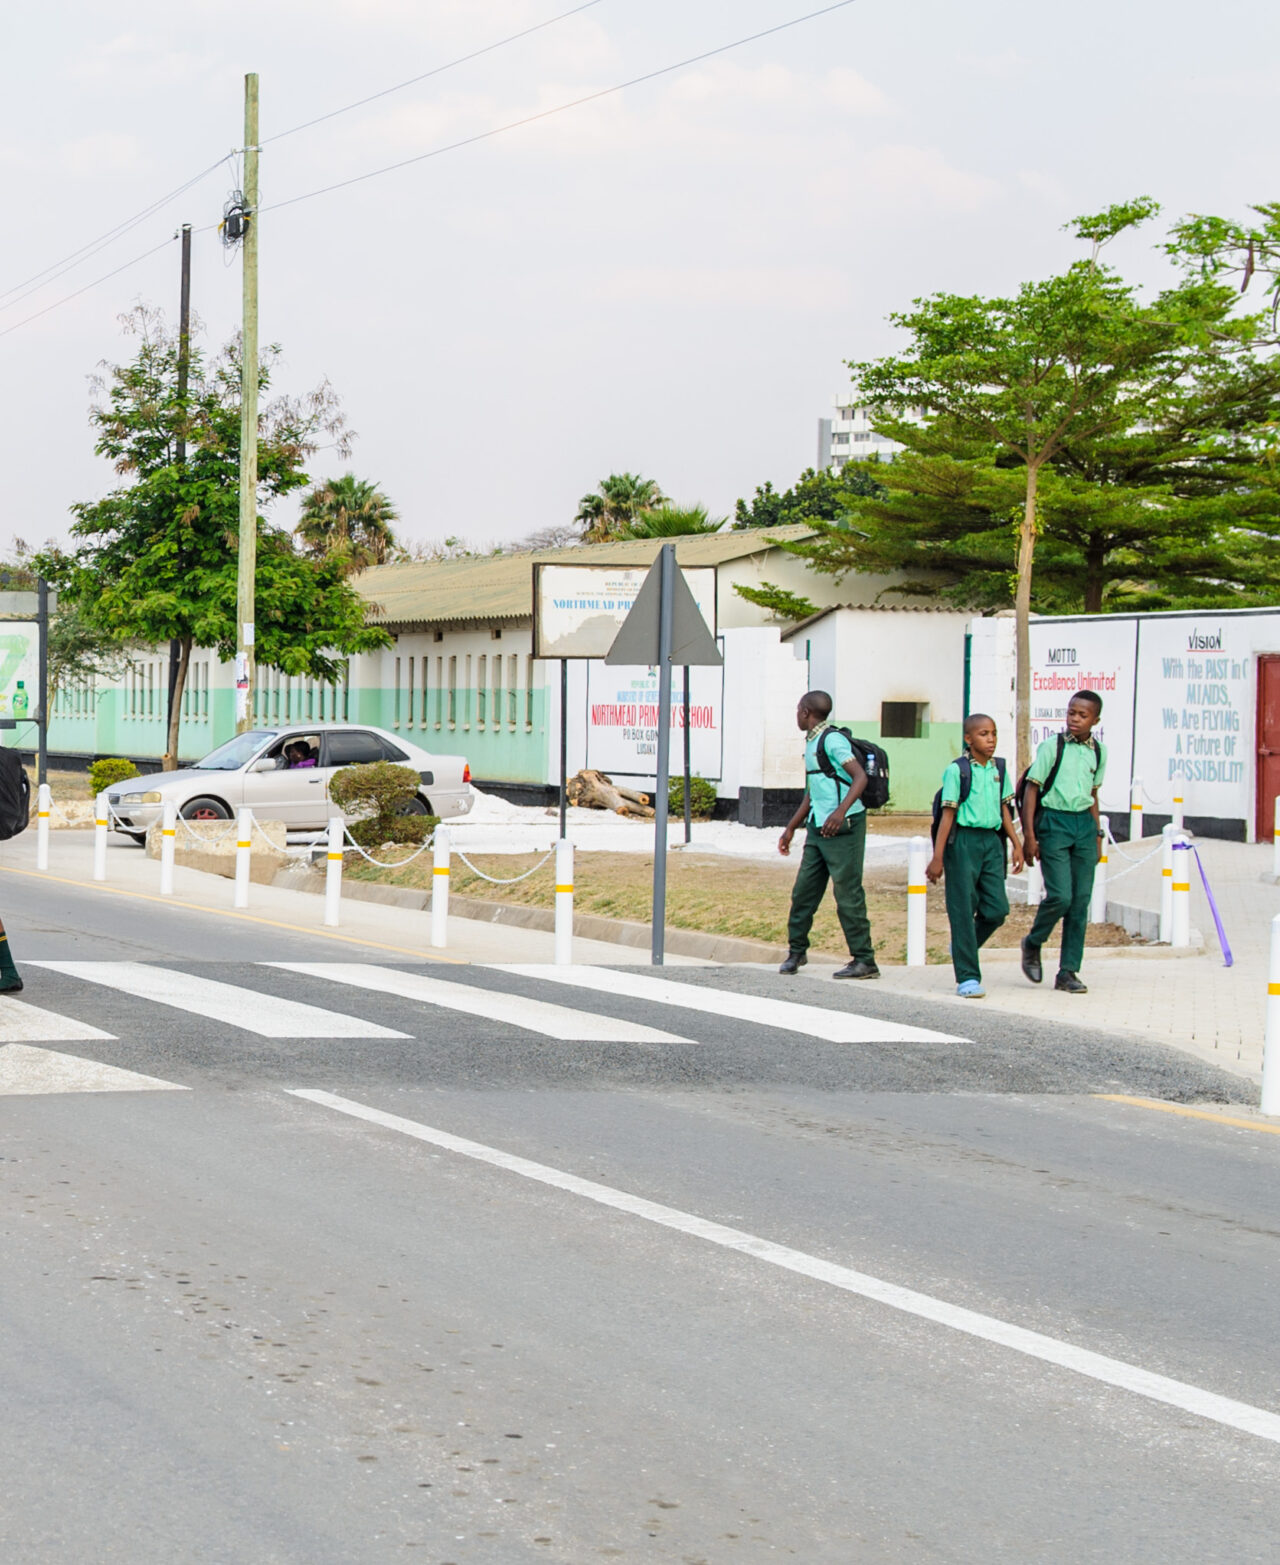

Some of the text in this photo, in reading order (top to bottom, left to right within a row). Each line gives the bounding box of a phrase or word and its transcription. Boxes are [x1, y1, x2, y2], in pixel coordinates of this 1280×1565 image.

[553, 599, 614, 610] NORTHMEAD
[1189, 628, 1222, 649] VISION
[1048, 648, 1077, 663] MOTTO
[1162, 657, 1184, 680] With
[1187, 658, 1203, 679] the
[1205, 658, 1229, 680] PAST
[1231, 659, 1241, 680] in
[1186, 683, 1232, 707] MINDS,
[591, 704, 636, 726] NORTHMEAD
[1162, 708, 1240, 731] We Are FLYING
[632, 729, 643, 741] BOX
[1176, 734, 1182, 754] A
[1187, 734, 1221, 756] Future
